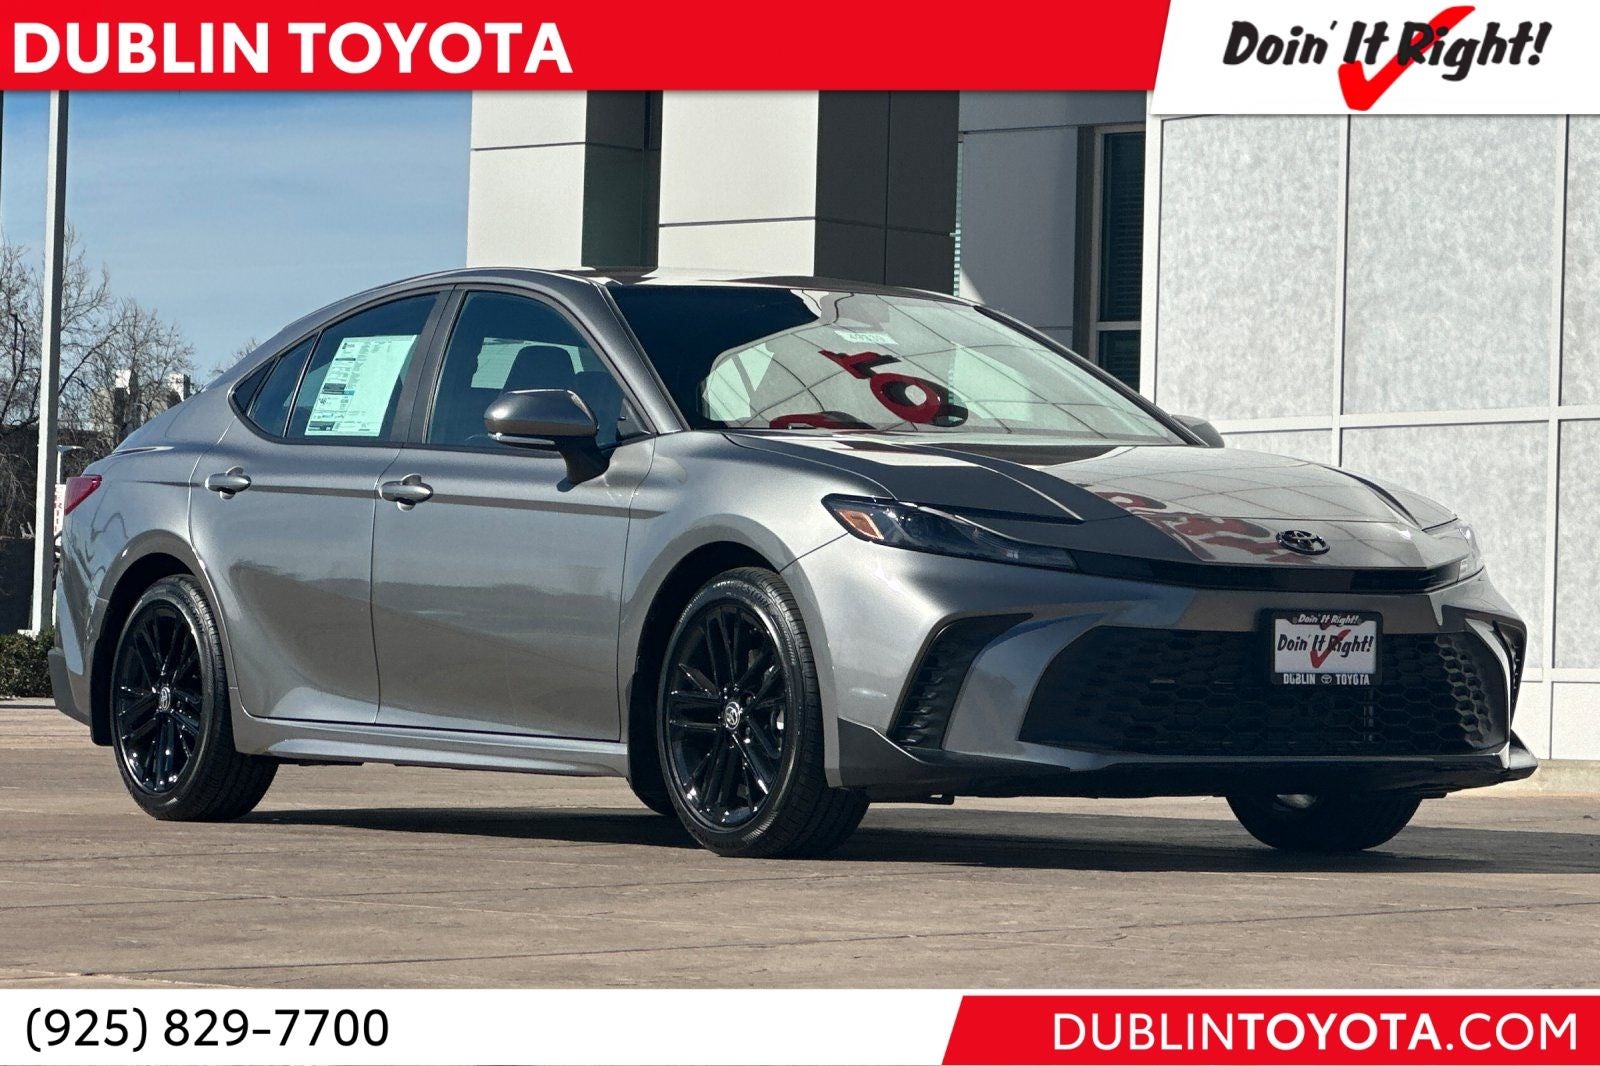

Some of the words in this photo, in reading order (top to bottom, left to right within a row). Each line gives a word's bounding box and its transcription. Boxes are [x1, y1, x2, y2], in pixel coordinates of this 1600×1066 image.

[1320, 613, 1329, 624] It
[1331, 614, 1359, 627] Right!
[1276, 633, 1311, 652] Doin'
[1312, 634, 1326, 652] It
[1328, 635, 1375, 658] Right!
[1283, 673, 1316, 685] DUBLIN
[1335, 673, 1371, 686] TOYOTA
